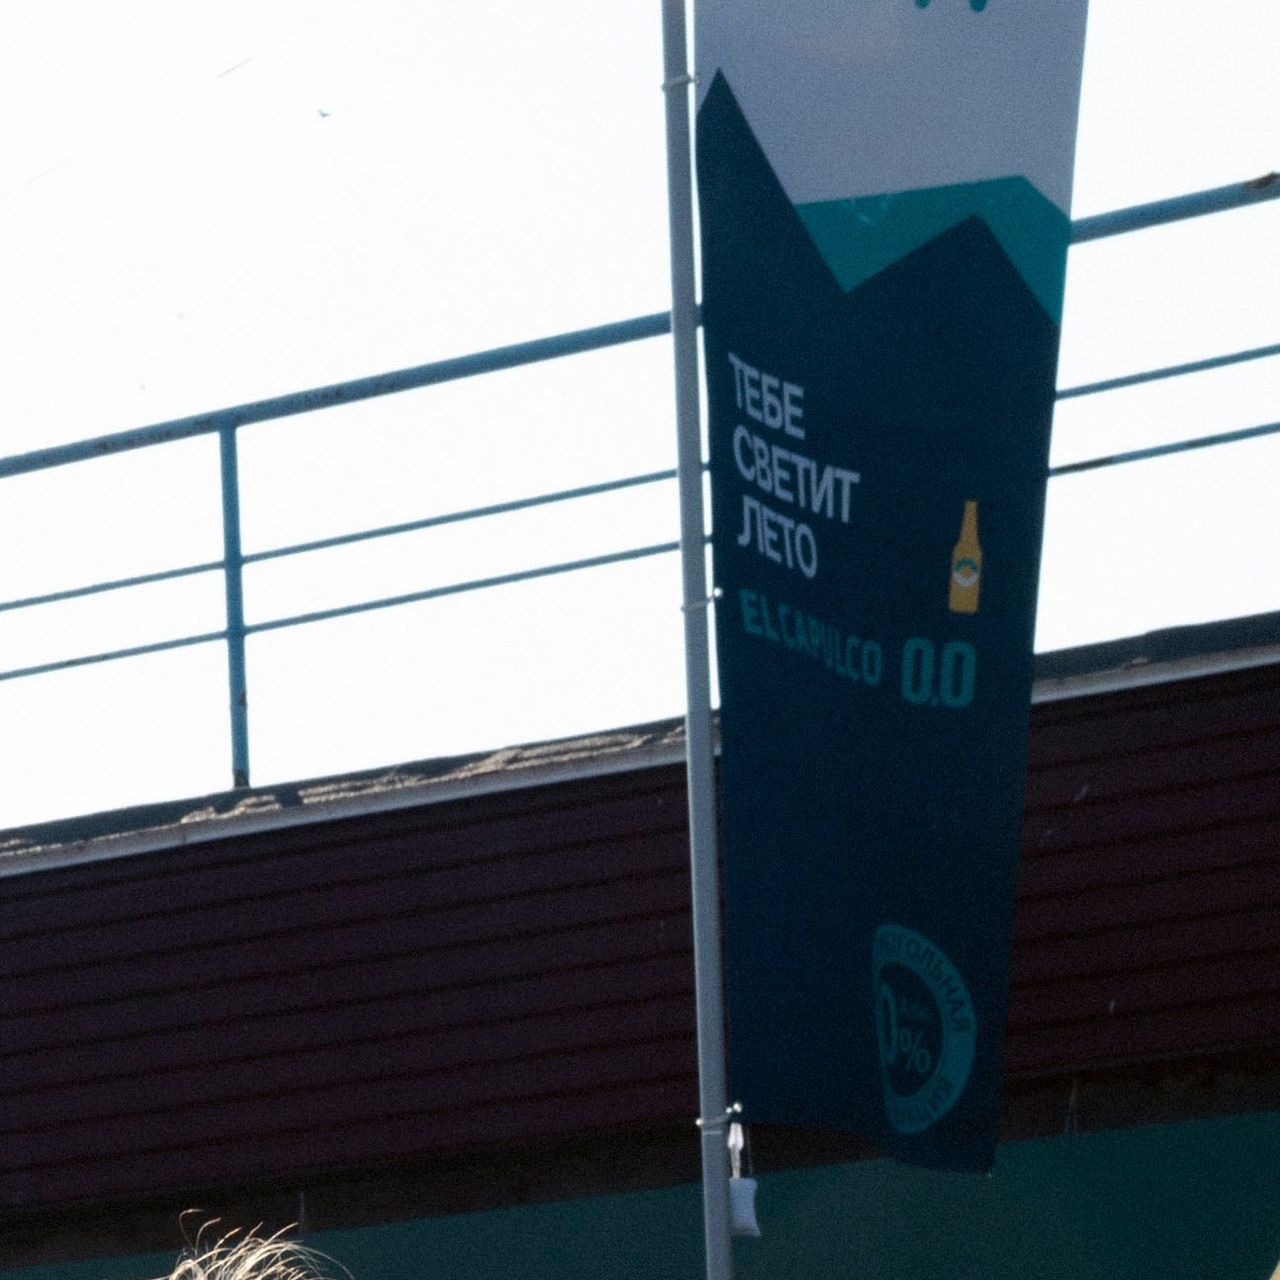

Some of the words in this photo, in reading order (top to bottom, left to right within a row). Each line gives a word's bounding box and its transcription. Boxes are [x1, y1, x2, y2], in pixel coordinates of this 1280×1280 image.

[728, 352, 806, 440] ТЕБЕ
[732, 424, 861, 524] СВЕТИТ
[737, 494, 818, 579] ЛЕТО
